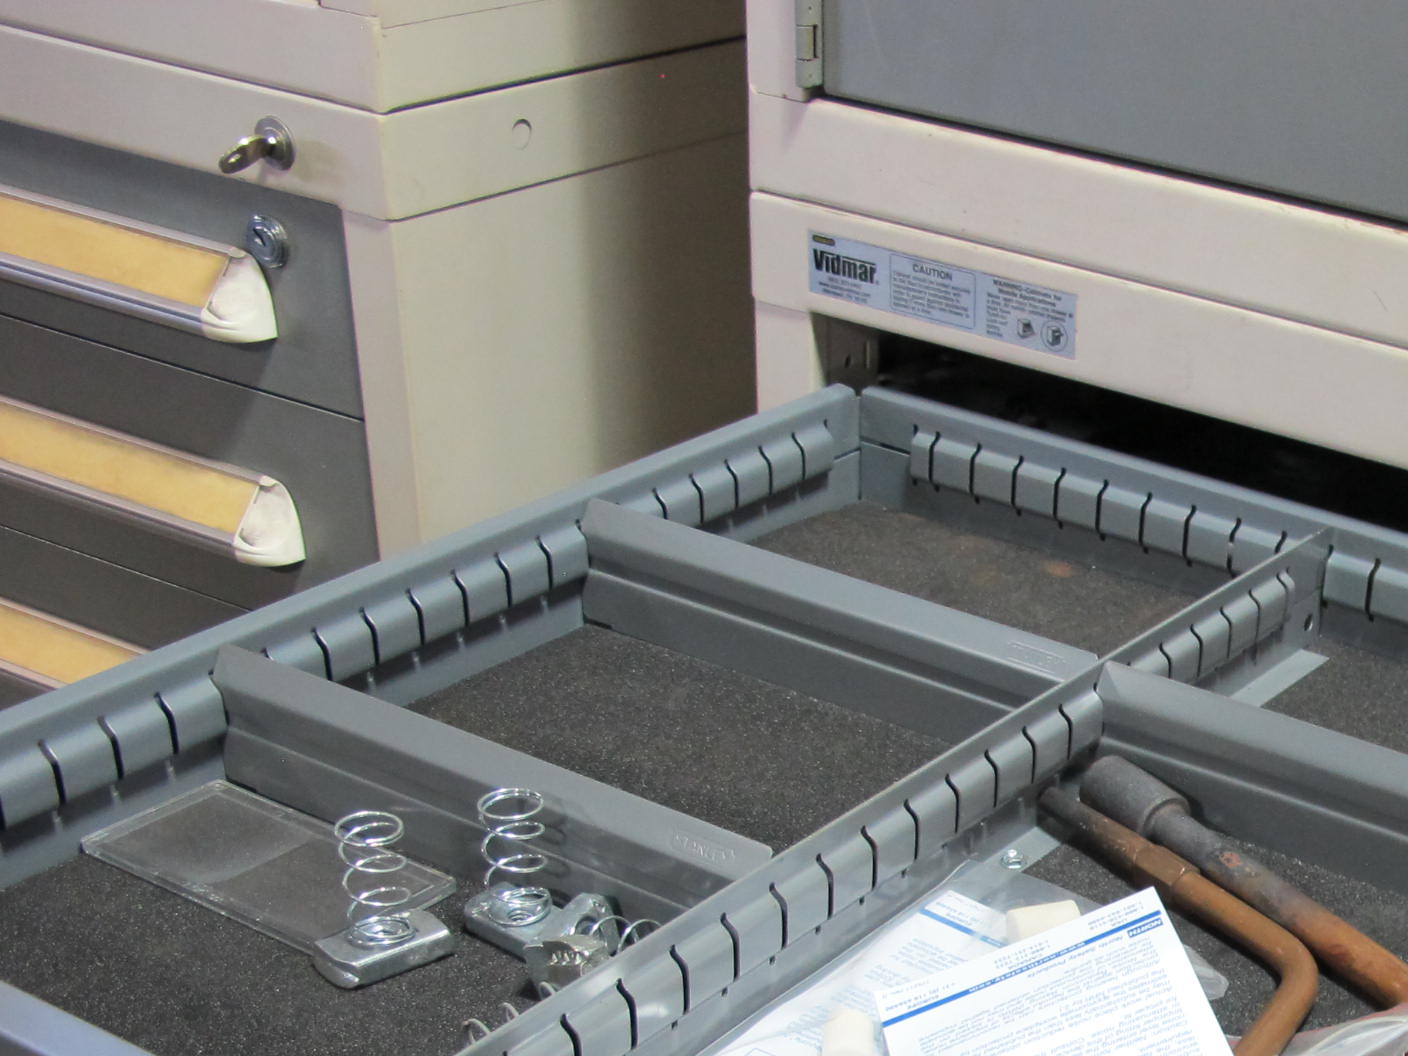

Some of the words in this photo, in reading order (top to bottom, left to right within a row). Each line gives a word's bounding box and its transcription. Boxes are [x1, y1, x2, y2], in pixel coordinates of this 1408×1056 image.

[813, 248, 876, 284] Vidmar
[913, 264, 952, 281] CAUTION
[1127, 919, 1162, 937] NORTH
